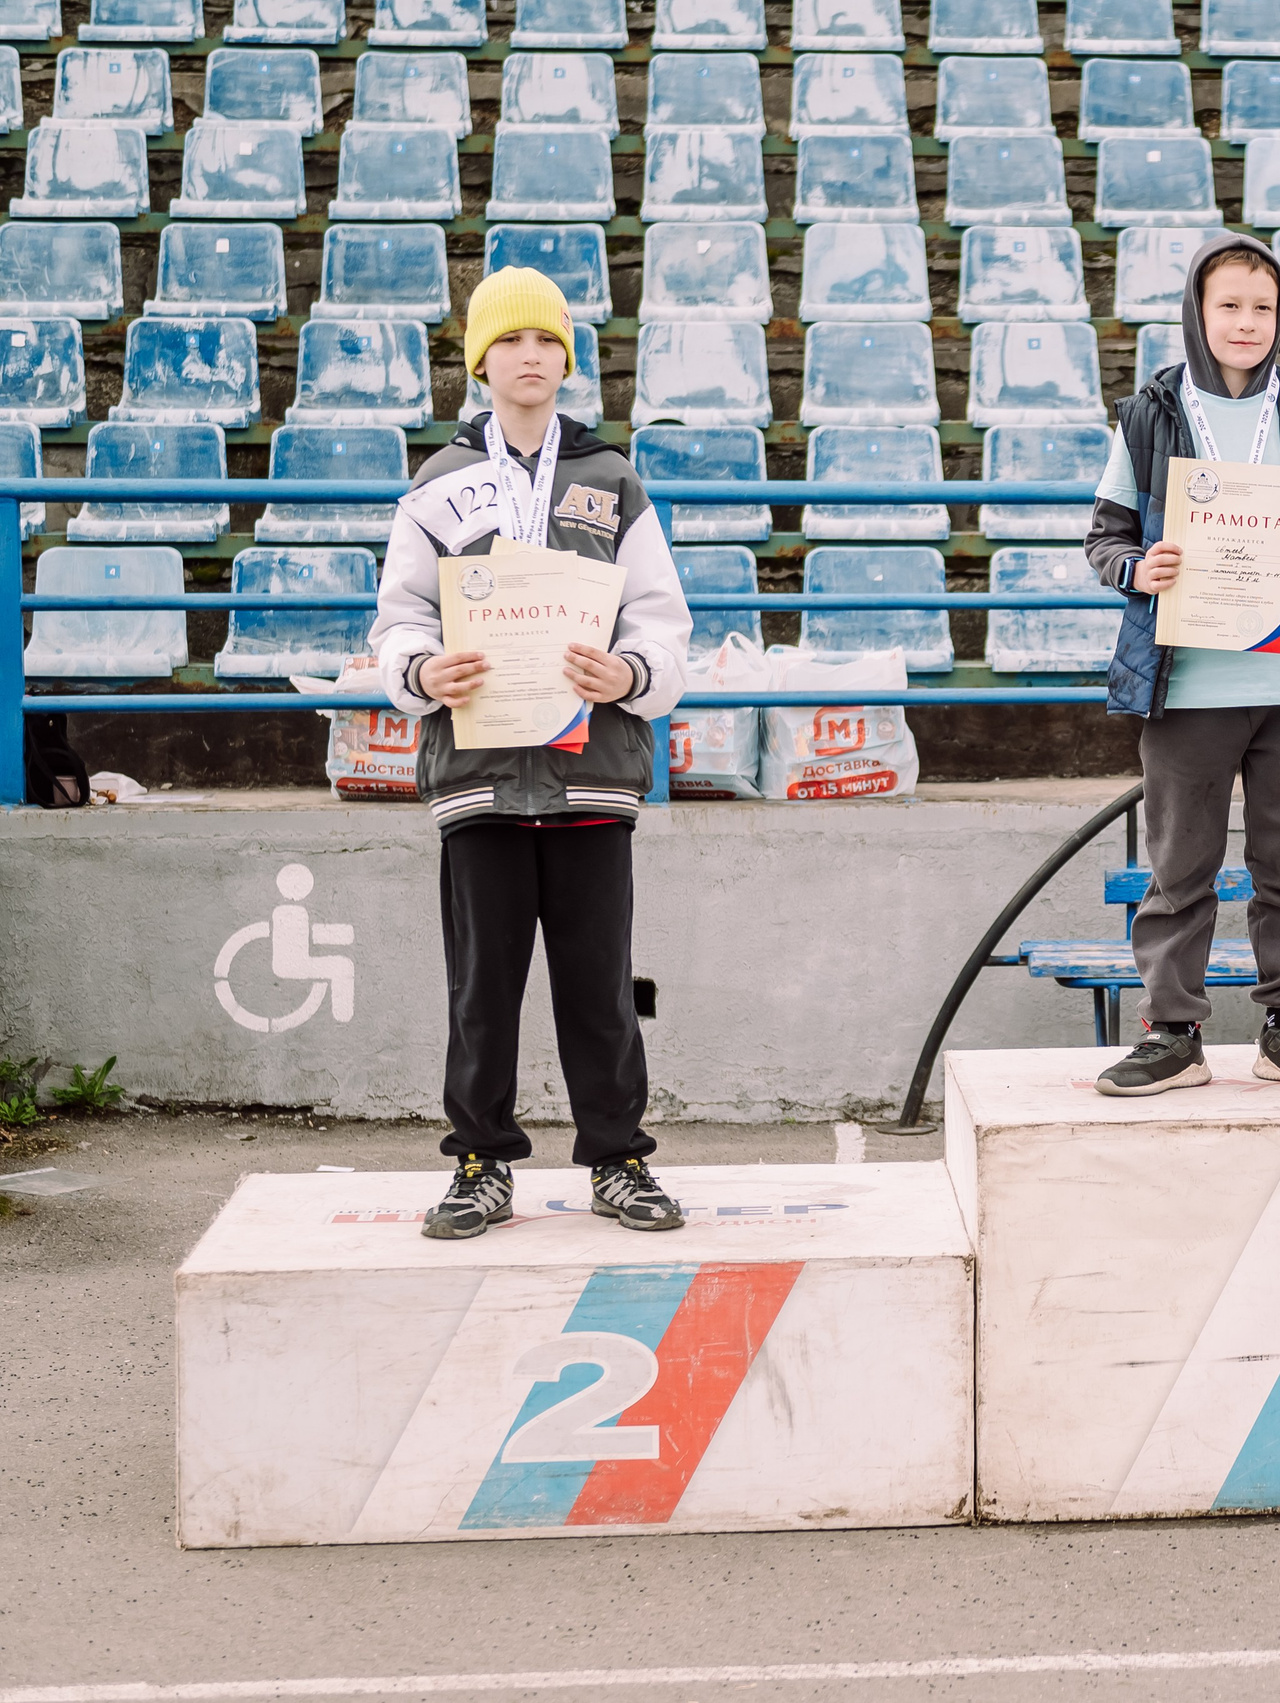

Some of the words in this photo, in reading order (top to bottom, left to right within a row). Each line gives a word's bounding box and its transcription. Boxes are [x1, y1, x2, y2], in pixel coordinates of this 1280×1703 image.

[444, 482, 498, 525] 122
[554, 482, 622, 533] ACL
[559, 519, 577, 528] NEW
[1207, 536, 1265, 545] НАГРАЖДАЕТСЯ
[468, 604, 568, 622] ГРАМОТА
[353, 760, 415, 776] Достав
[802, 759, 881, 778] Доставка
[669, 779, 714, 788] тавка
[798, 787, 815, 799] от
[820, 782, 838, 795] 15
[842, 776, 889, 792] минут
[501, 1332, 660, 1464] 2
